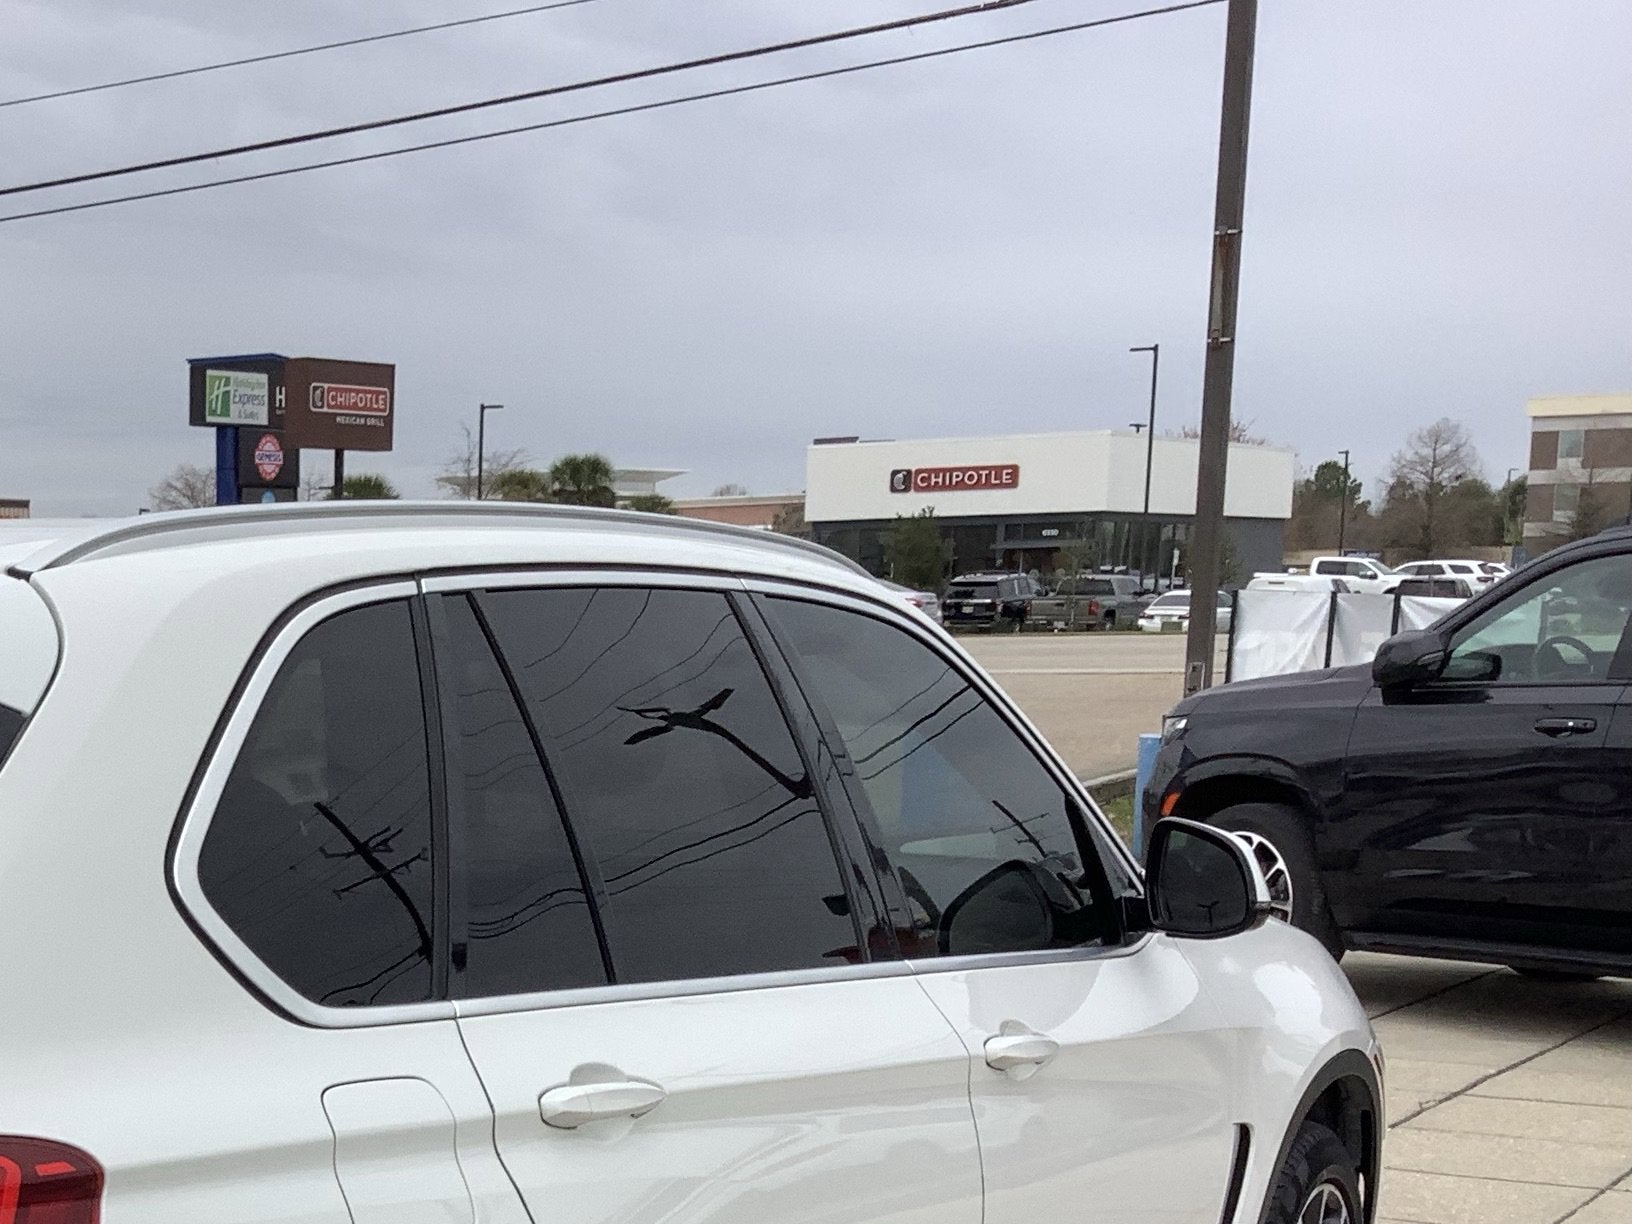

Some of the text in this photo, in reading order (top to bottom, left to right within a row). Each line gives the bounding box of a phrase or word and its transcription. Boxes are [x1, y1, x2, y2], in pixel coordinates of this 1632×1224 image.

[328, 391, 386, 409] CHIPOTLE
[335, 415, 365, 426] MEXICAN
[917, 469, 1014, 487] CHIPOTLE
